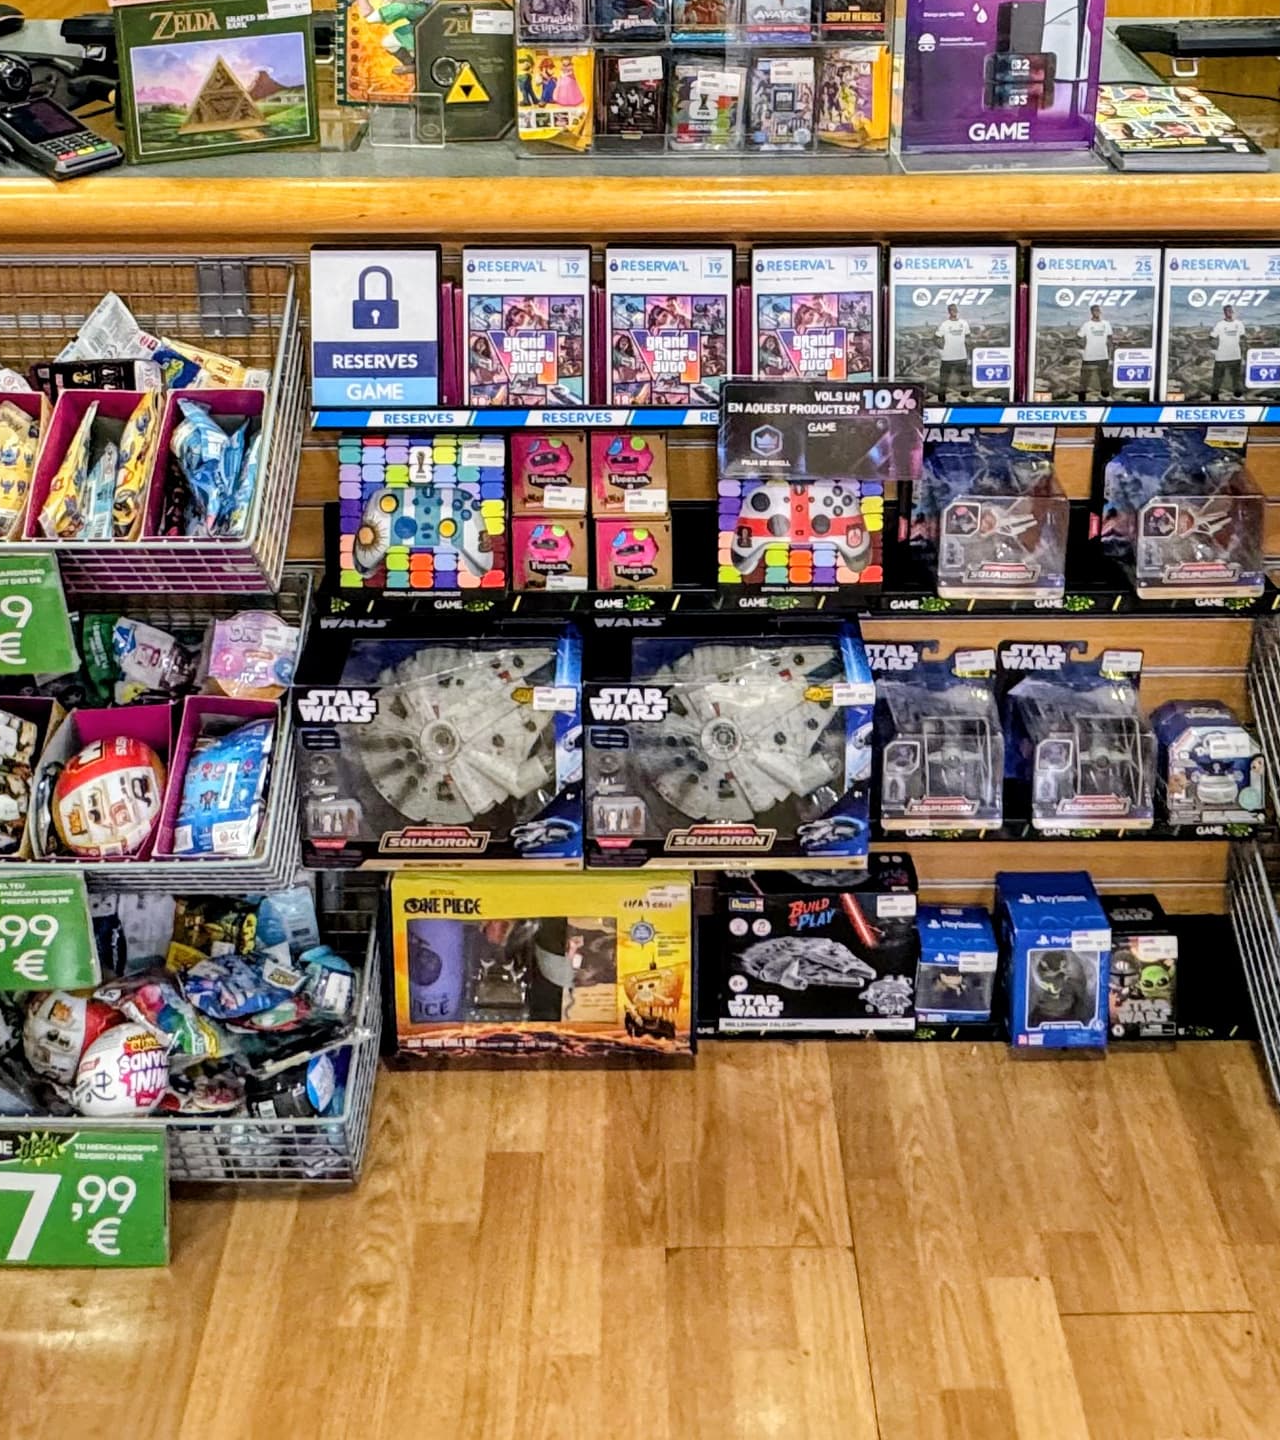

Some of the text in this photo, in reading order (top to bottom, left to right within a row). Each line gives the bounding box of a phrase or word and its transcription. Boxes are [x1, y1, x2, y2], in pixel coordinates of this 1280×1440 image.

[150, 10, 221, 40] ZELDA
[969, 122, 1030, 141] GAME
[478, 259, 547, 273] RESERVA'L
[564, 260, 580, 274] 19
[620, 259, 690, 273] RESERVA'L
[904, 257, 974, 271] RESERVA'L
[991, 259, 1008, 273] 25
[1049, 257, 1118, 271] RESERVA'L
[1181, 257, 1251, 272] RESERVA'L
[931, 288, 993, 307] FC27
[1075, 288, 1137, 307] FC27
[1207, 288, 1269, 307] FC27
[503, 334, 546, 351] grand
[332, 353, 418, 371] RESERVES
[511, 348, 554, 363] theft
[508, 360, 544, 374] auto
[346, 383, 404, 401] GAME
[815, 391, 860, 402] VOLS UN
[863, 389, 916, 409] 10%
[728, 403, 860, 415] EN AQUEST PRODUCTES?
[1017, 408, 1087, 421] RESERVES
[1175, 408, 1245, 421] RESERVES
[383, 412, 454, 425] RESERVES
[542, 411, 613, 424] RESERVES
[808, 422, 837, 432] GAME
[1007, 644, 1062, 658] STAR
[1001, 657, 1067, 670] WARS
[309, 689, 373, 706] STAR
[600, 688, 663, 704] STAR
[298, 705, 376, 723] WARS
[589, 704, 669, 721] WARS
[387, 837, 482, 848] SQUADRON
[672, 835, 767, 847] SQUADRON
[1036, 894, 1086, 904] PlayStation
[788, 898, 831, 917] BUILD
[797, 909, 836, 930] PLAY
[13, 950, 47, 981] €
[734, 996, 779, 1007] STAR
[72, 1175, 136, 1219] ,99
[88, 1218, 122, 1256] €
